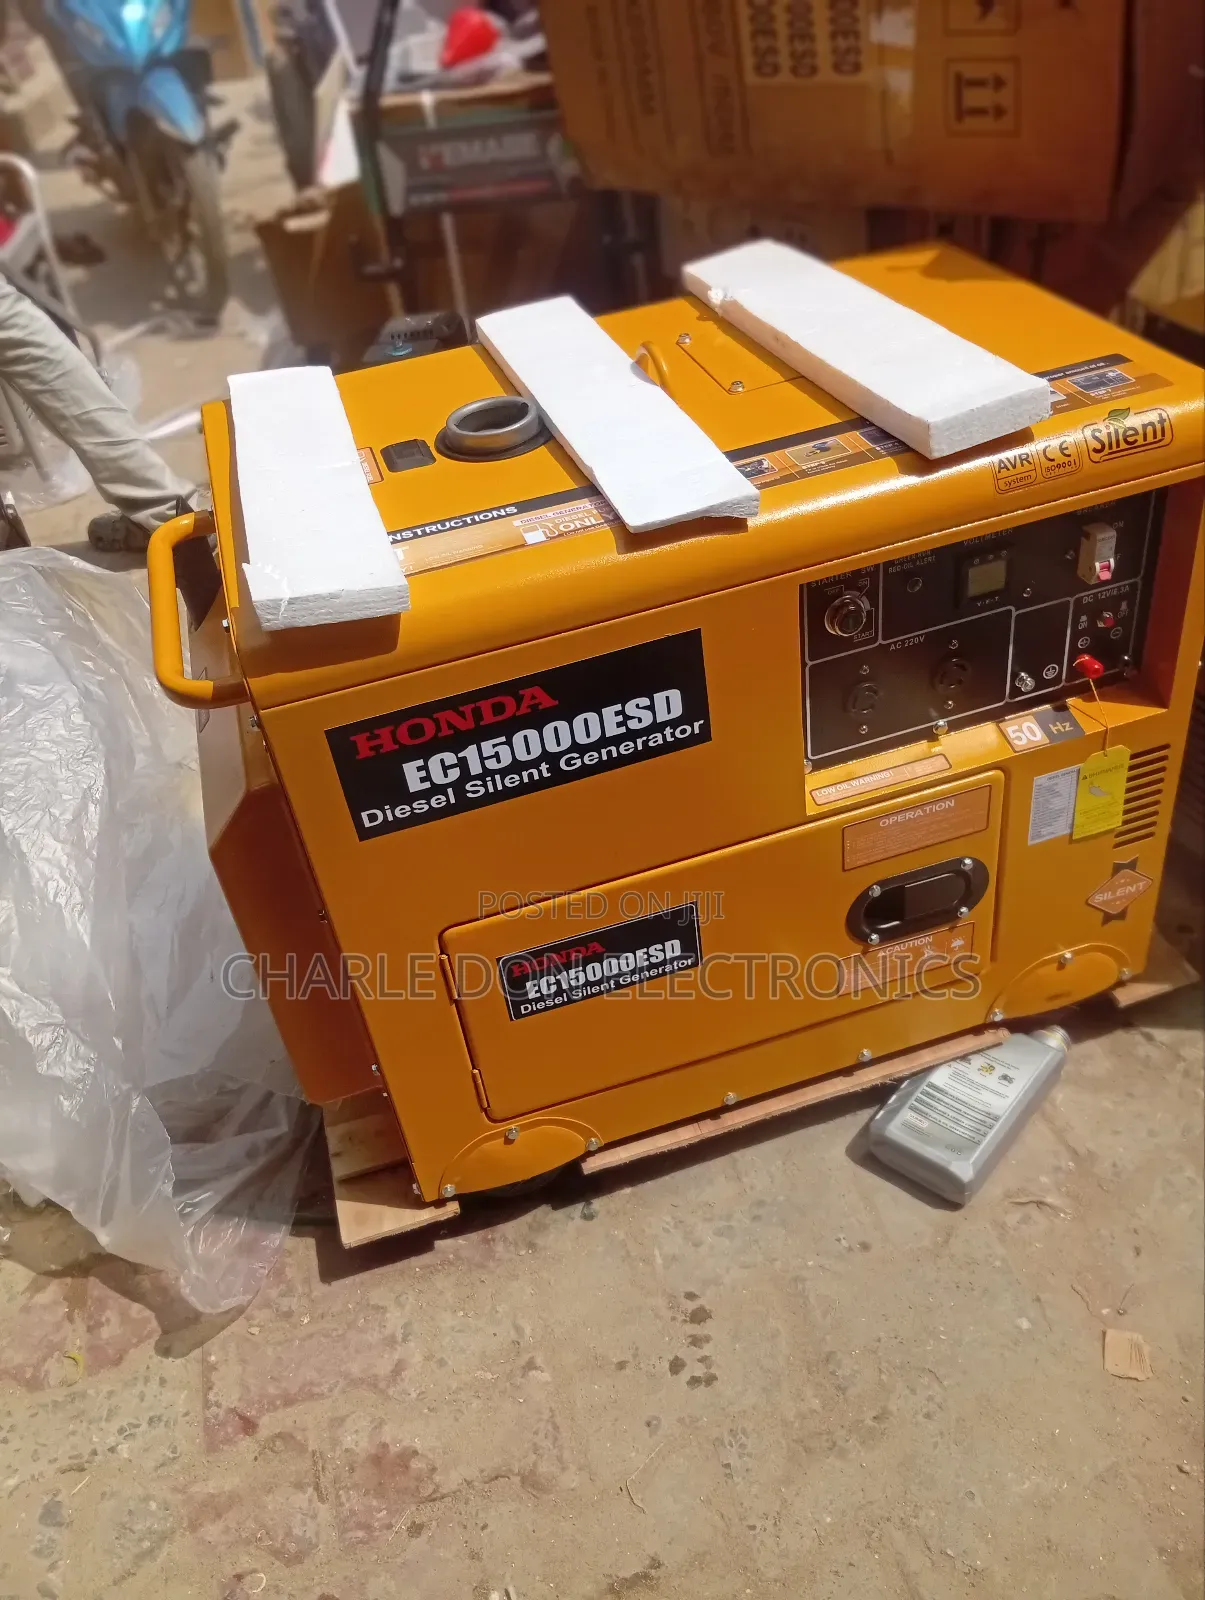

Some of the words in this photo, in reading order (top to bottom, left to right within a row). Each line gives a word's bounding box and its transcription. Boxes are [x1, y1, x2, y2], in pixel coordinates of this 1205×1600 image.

[1087, 413, 1167, 454] Silent
[996, 451, 1033, 474] AVR
[1044, 458, 1078, 474] ISO9001
[1003, 473, 1032, 488] system
[559, 511, 616, 532] ONLY
[1082, 595, 1094, 604] DC
[853, 630, 873, 641] START
[1078, 621, 1088, 630] ON
[889, 642, 902, 652] AC
[904, 635, 925, 648] 220V
[349, 685, 558, 760] HONDA
[1006, 721, 1042, 745] 50
[1049, 721, 1074, 734] Hz
[402, 688, 684, 793] EC15000ESD
[361, 788, 456, 829] Diesel
[465, 762, 551, 800] Silent
[559, 719, 704, 772] Generator
[816, 786, 837, 798] LOW
[836, 781, 852, 793] OIL
[850, 771, 894, 788] WARNING!
[879, 799, 955, 827] OPERATION
[1094, 880, 1148, 903] SILENT
[886, 935, 933, 955] CAUTION
[511, 942, 606, 978] HONDA
[525, 938, 682, 1000] EC15000ESD
[520, 993, 568, 1015] Diesel
[572, 979, 616, 1000] Silent
[619, 956, 695, 986] Generator
